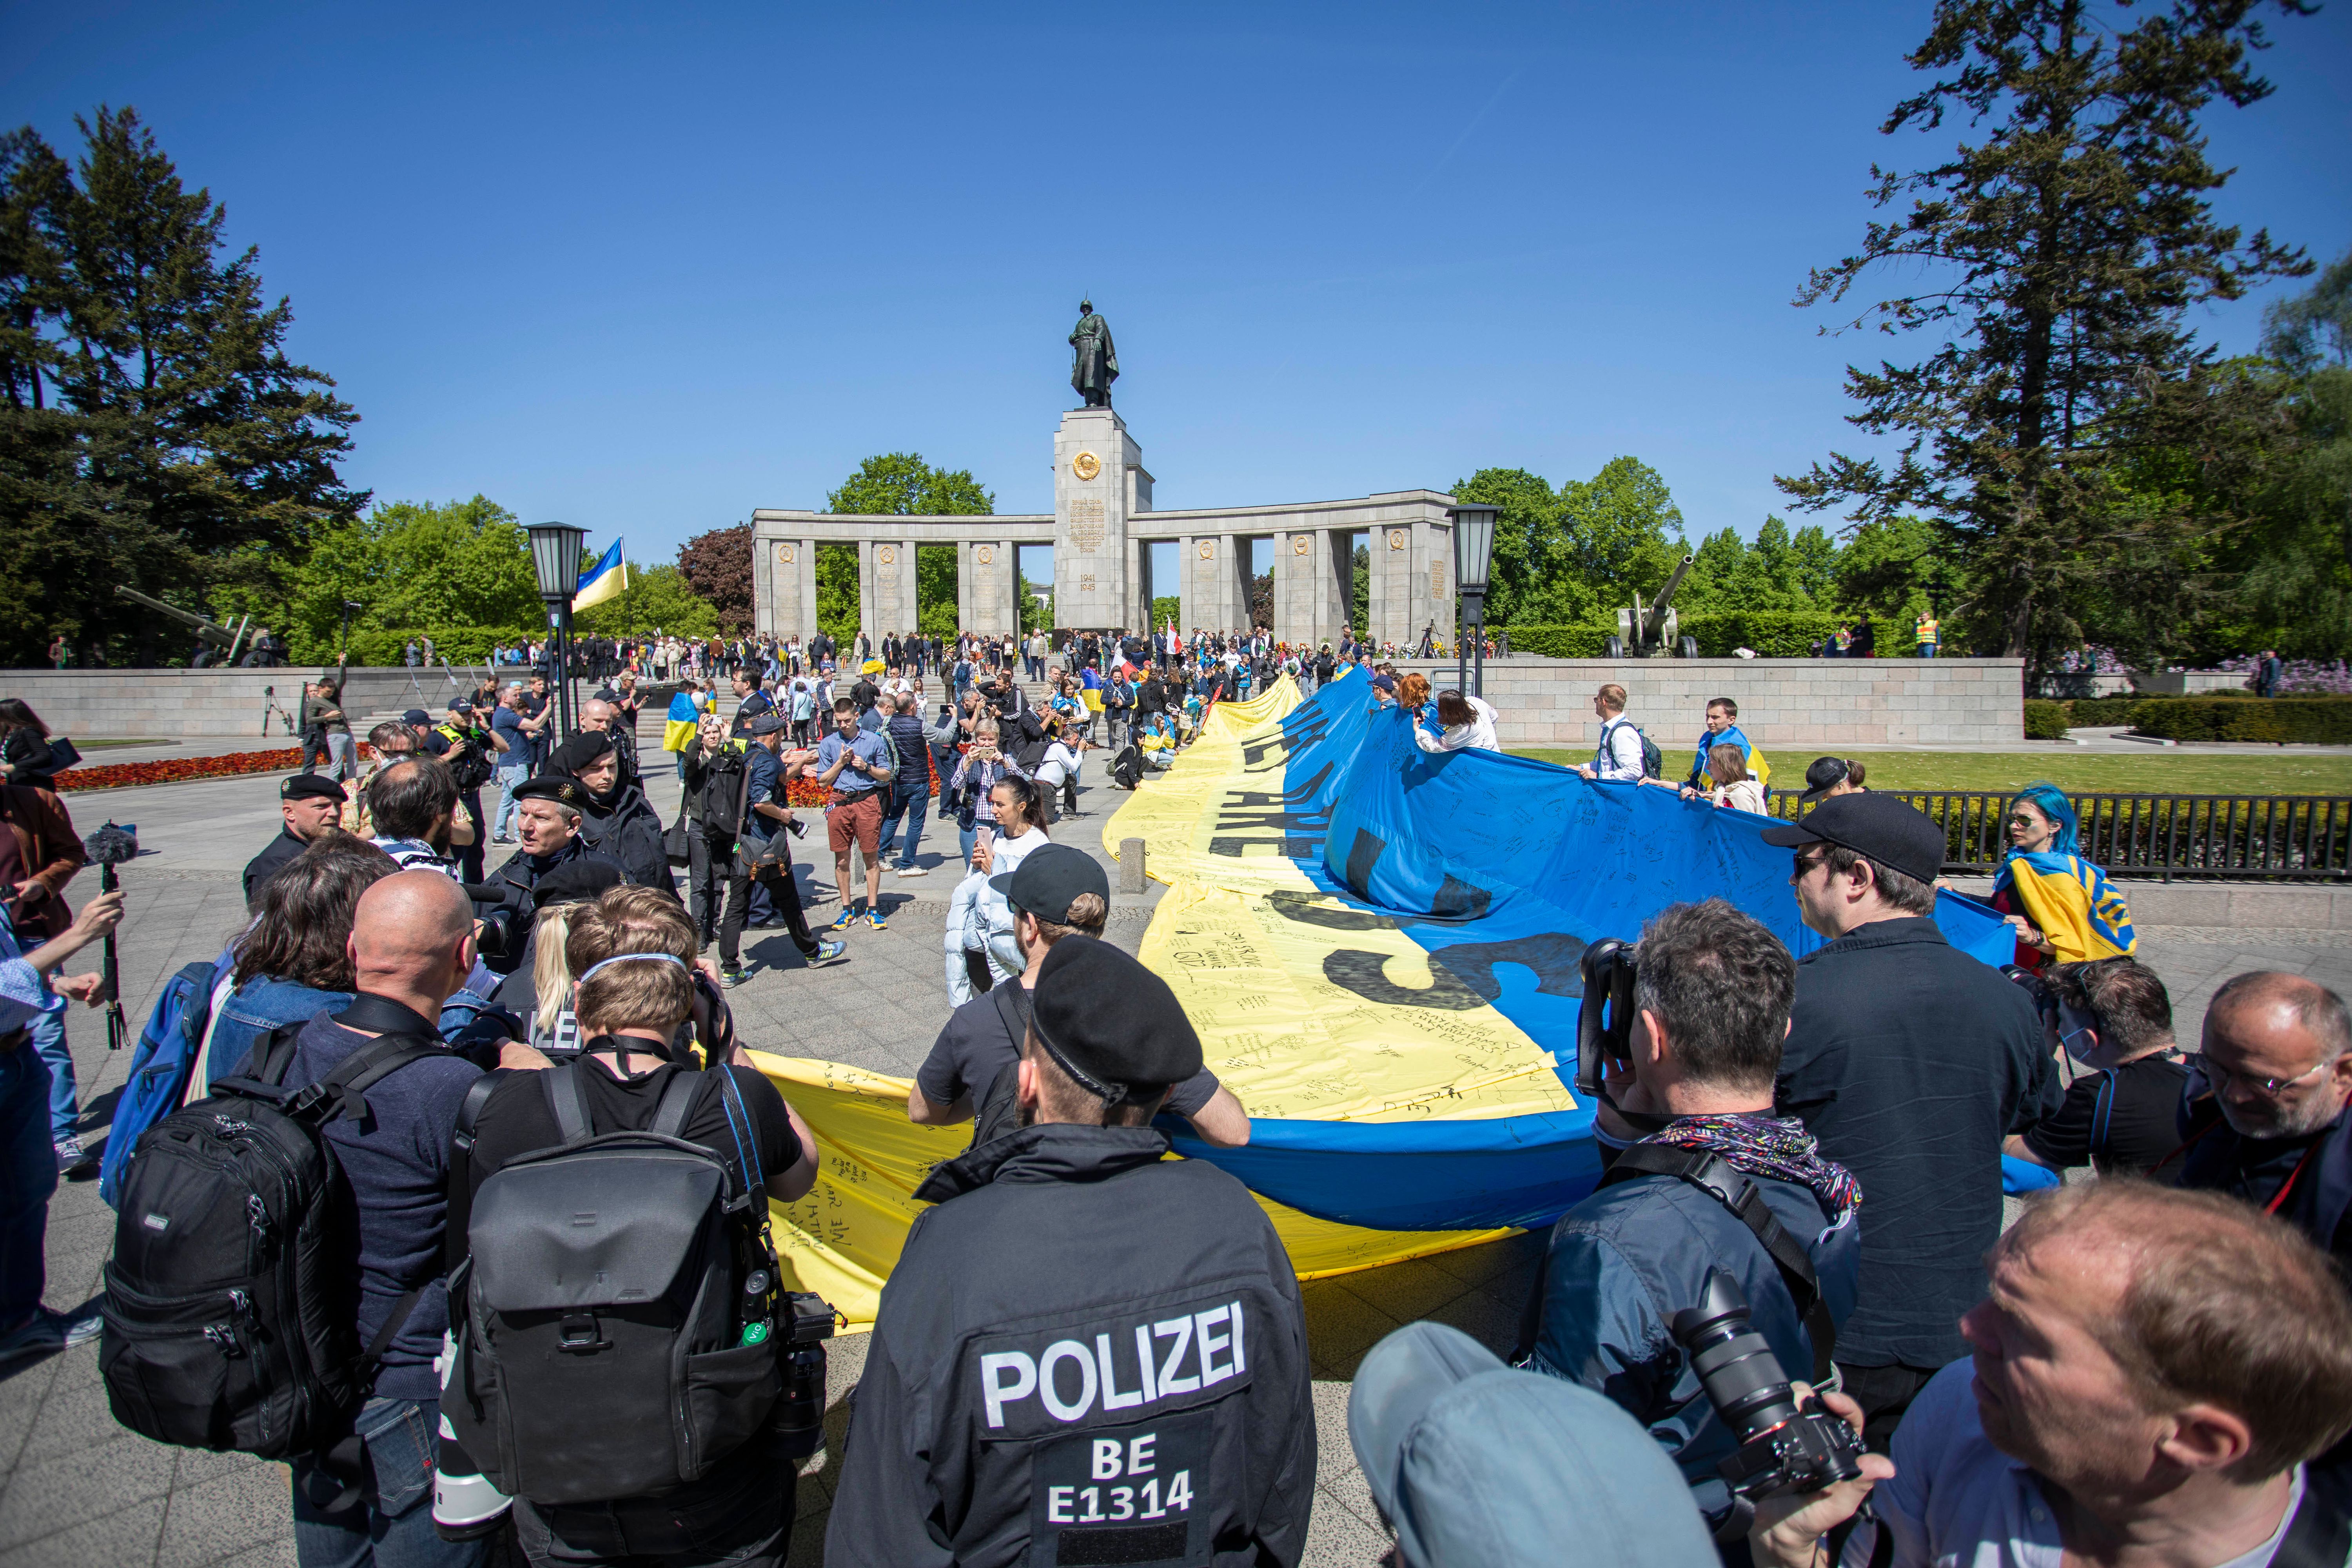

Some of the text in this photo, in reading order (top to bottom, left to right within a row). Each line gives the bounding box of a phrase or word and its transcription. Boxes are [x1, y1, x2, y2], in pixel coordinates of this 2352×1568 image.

[1574, 815, 1595, 827] LOVE
[1583, 808, 1599, 817] NOT
[1601, 833, 1624, 846] LOVE
[1224, 932, 1247, 944] STAY
[1203, 947, 1226, 969] UKRAINE
[980, 1300, 1245, 1428] POLIZEI
[1091, 1433, 1156, 1480] BE
[1048, 1470, 1194, 1524] E1314
